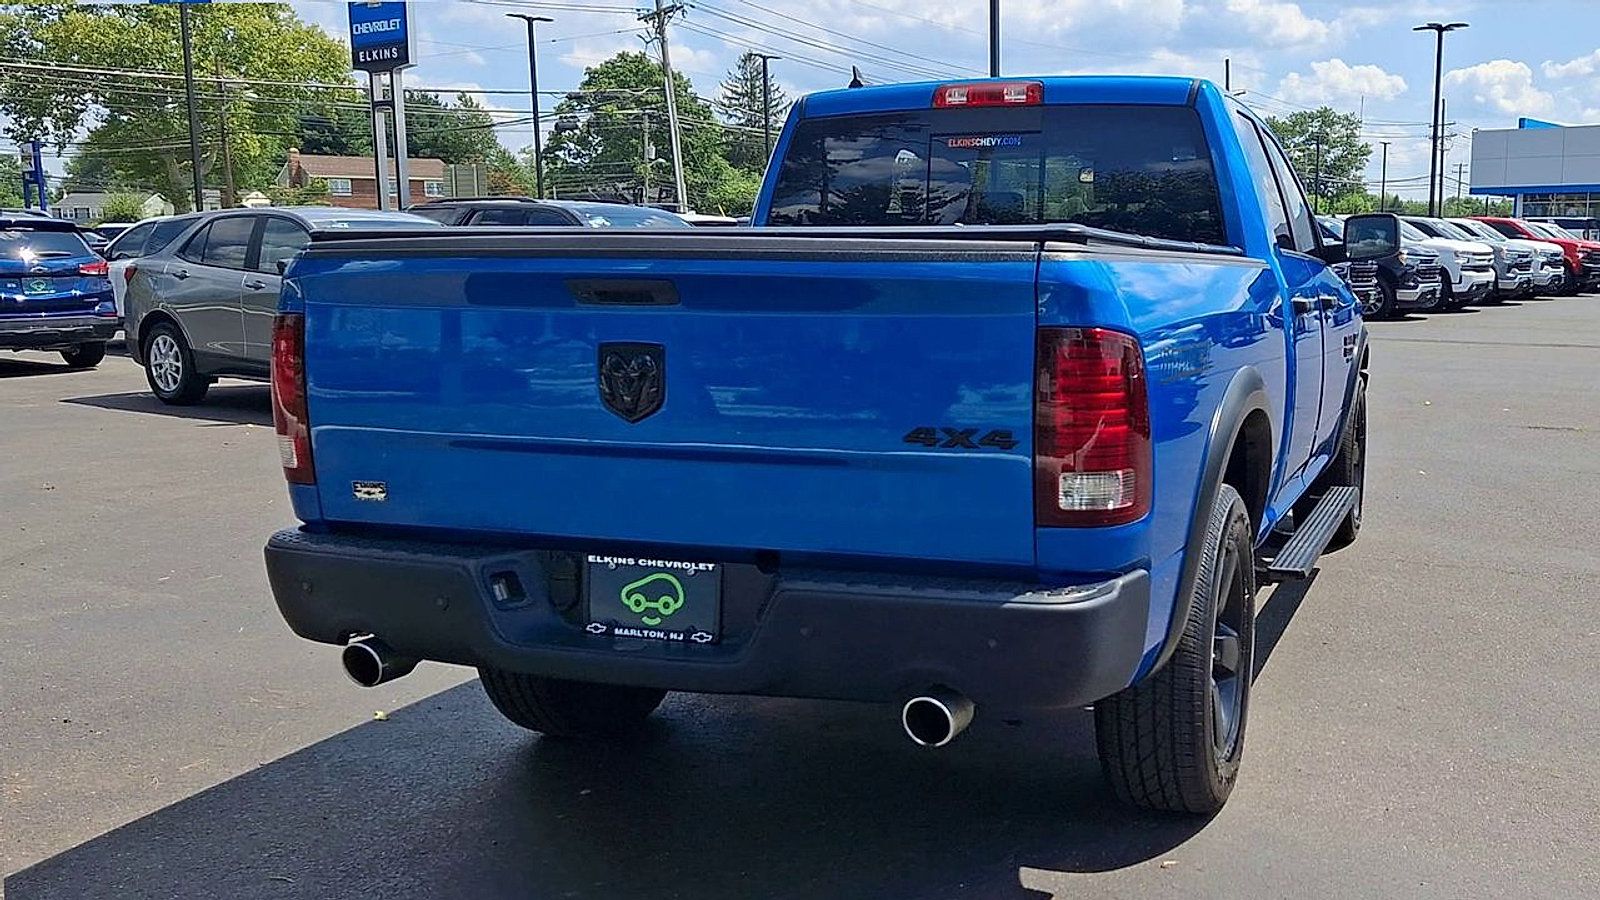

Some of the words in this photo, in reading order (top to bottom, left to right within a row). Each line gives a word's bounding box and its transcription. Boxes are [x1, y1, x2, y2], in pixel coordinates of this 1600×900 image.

[352, 18, 401, 35] CHEVROLET
[359, 47, 398, 62] ELKINS
[948, 137, 1021, 148] ELKINSCHEVY.COM
[587, 555, 635, 566] ELKINS
[638, 558, 716, 571] CHEVROLET
[614, 628, 668, 640] MARLTON,
[670, 632, 684, 641] NJ
